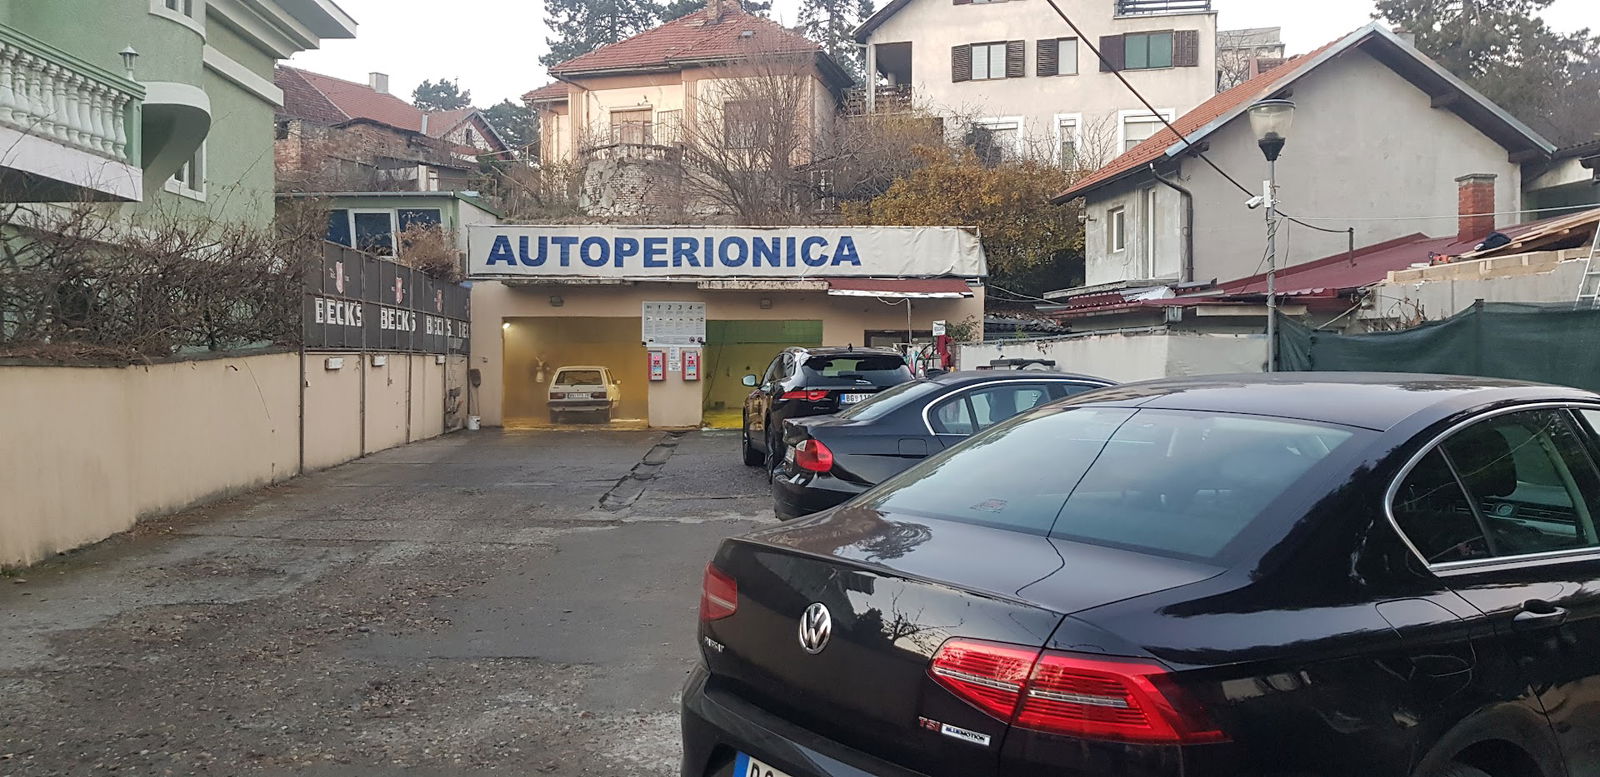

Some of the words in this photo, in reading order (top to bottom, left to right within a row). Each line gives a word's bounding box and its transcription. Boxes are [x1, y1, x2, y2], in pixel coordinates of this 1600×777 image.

[486, 235, 862, 267] AUTOPERIONICA
[380, 307, 416, 332] BECKS
[918, 715, 940, 732] TSI
